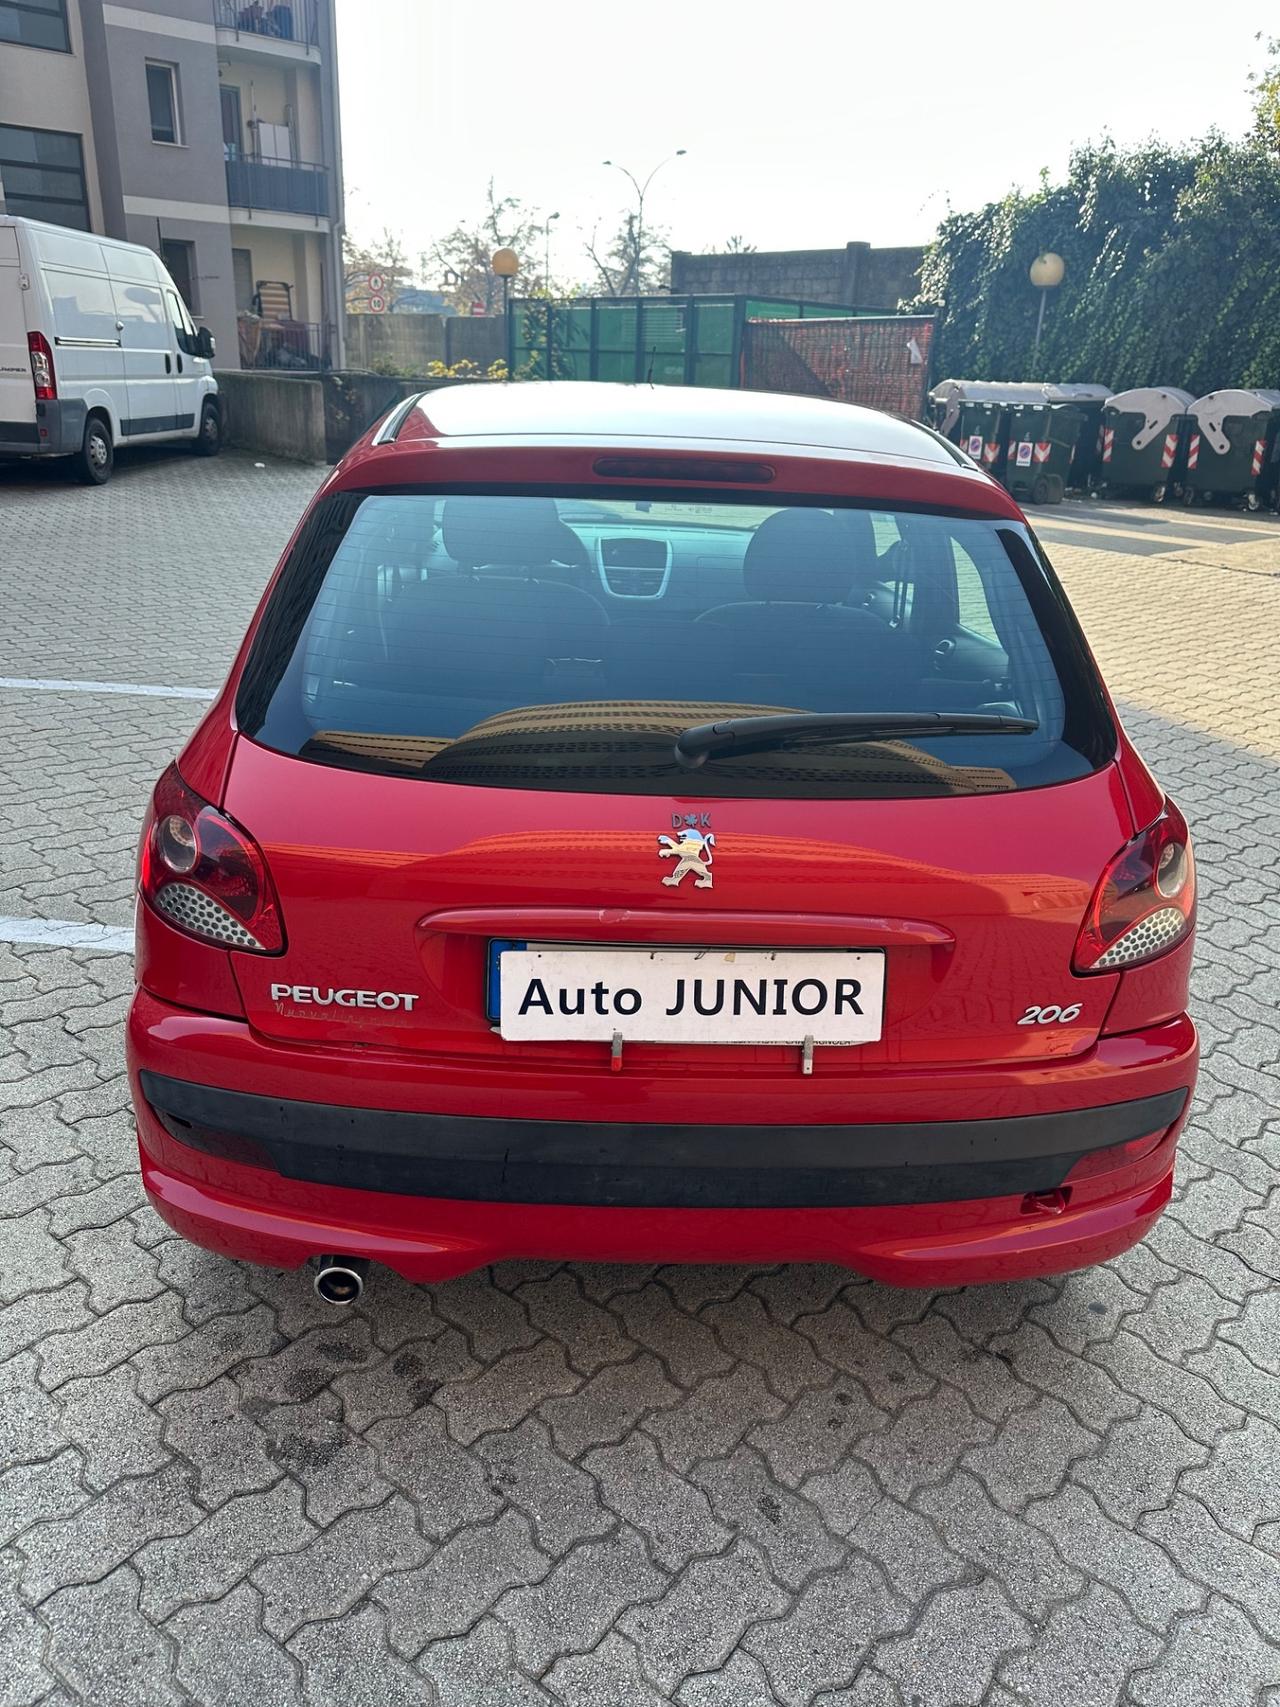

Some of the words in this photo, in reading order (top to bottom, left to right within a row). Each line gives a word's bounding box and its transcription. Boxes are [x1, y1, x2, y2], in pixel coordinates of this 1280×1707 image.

[270, 983, 420, 1012] PEUGEOT
[517, 978, 642, 1016] Auto
[665, 978, 865, 1016] JUNIOR
[1016, 1002, 1084, 1026] 206
